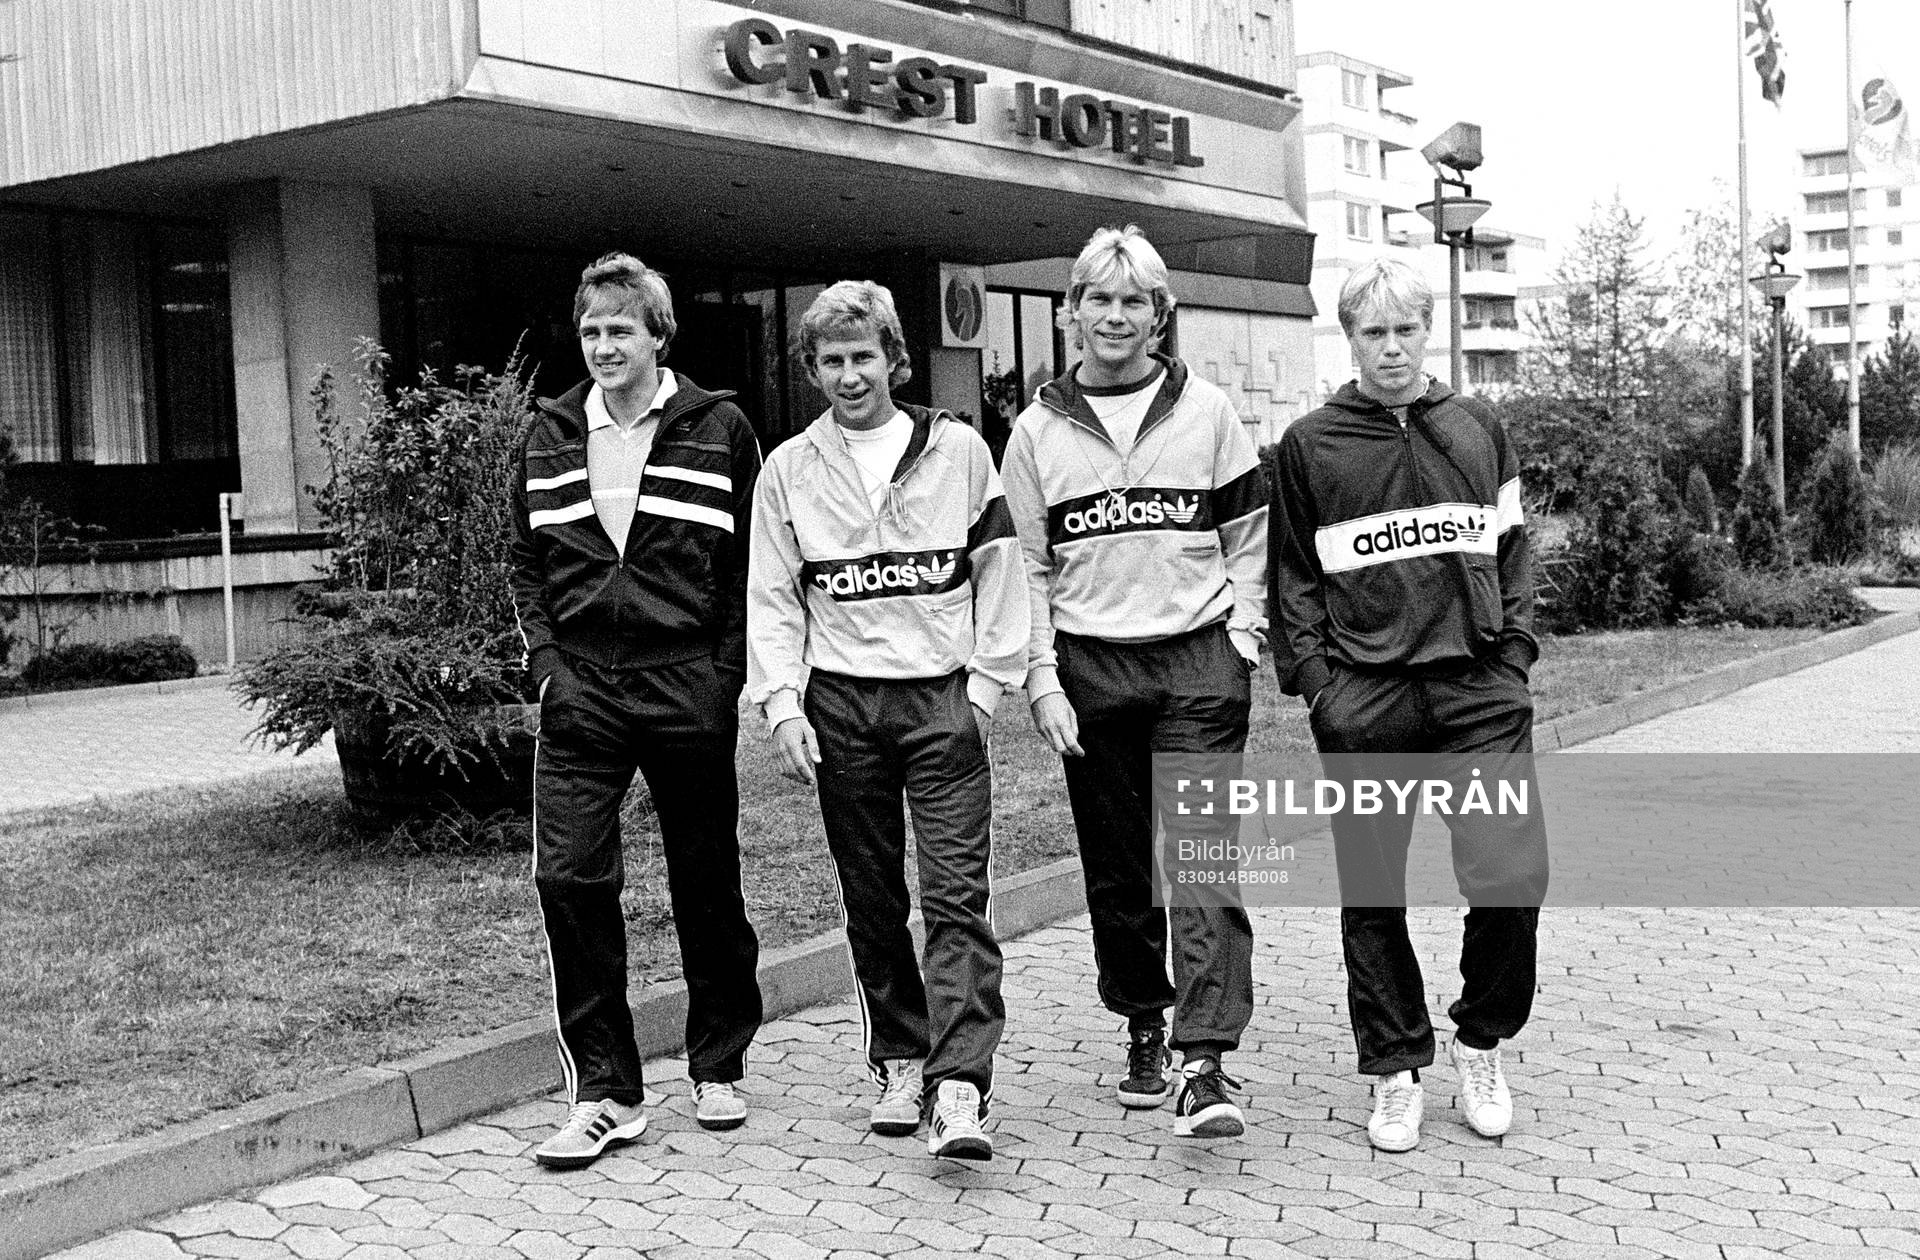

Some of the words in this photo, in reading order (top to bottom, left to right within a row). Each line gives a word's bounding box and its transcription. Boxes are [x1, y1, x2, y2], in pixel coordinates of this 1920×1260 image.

[724, 18, 988, 124] CREST
[1013, 81, 1205, 169] HOTEL
[1064, 495, 1165, 533] adidas
[1353, 518, 1459, 555] adidas
[815, 560, 919, 595] adidas
